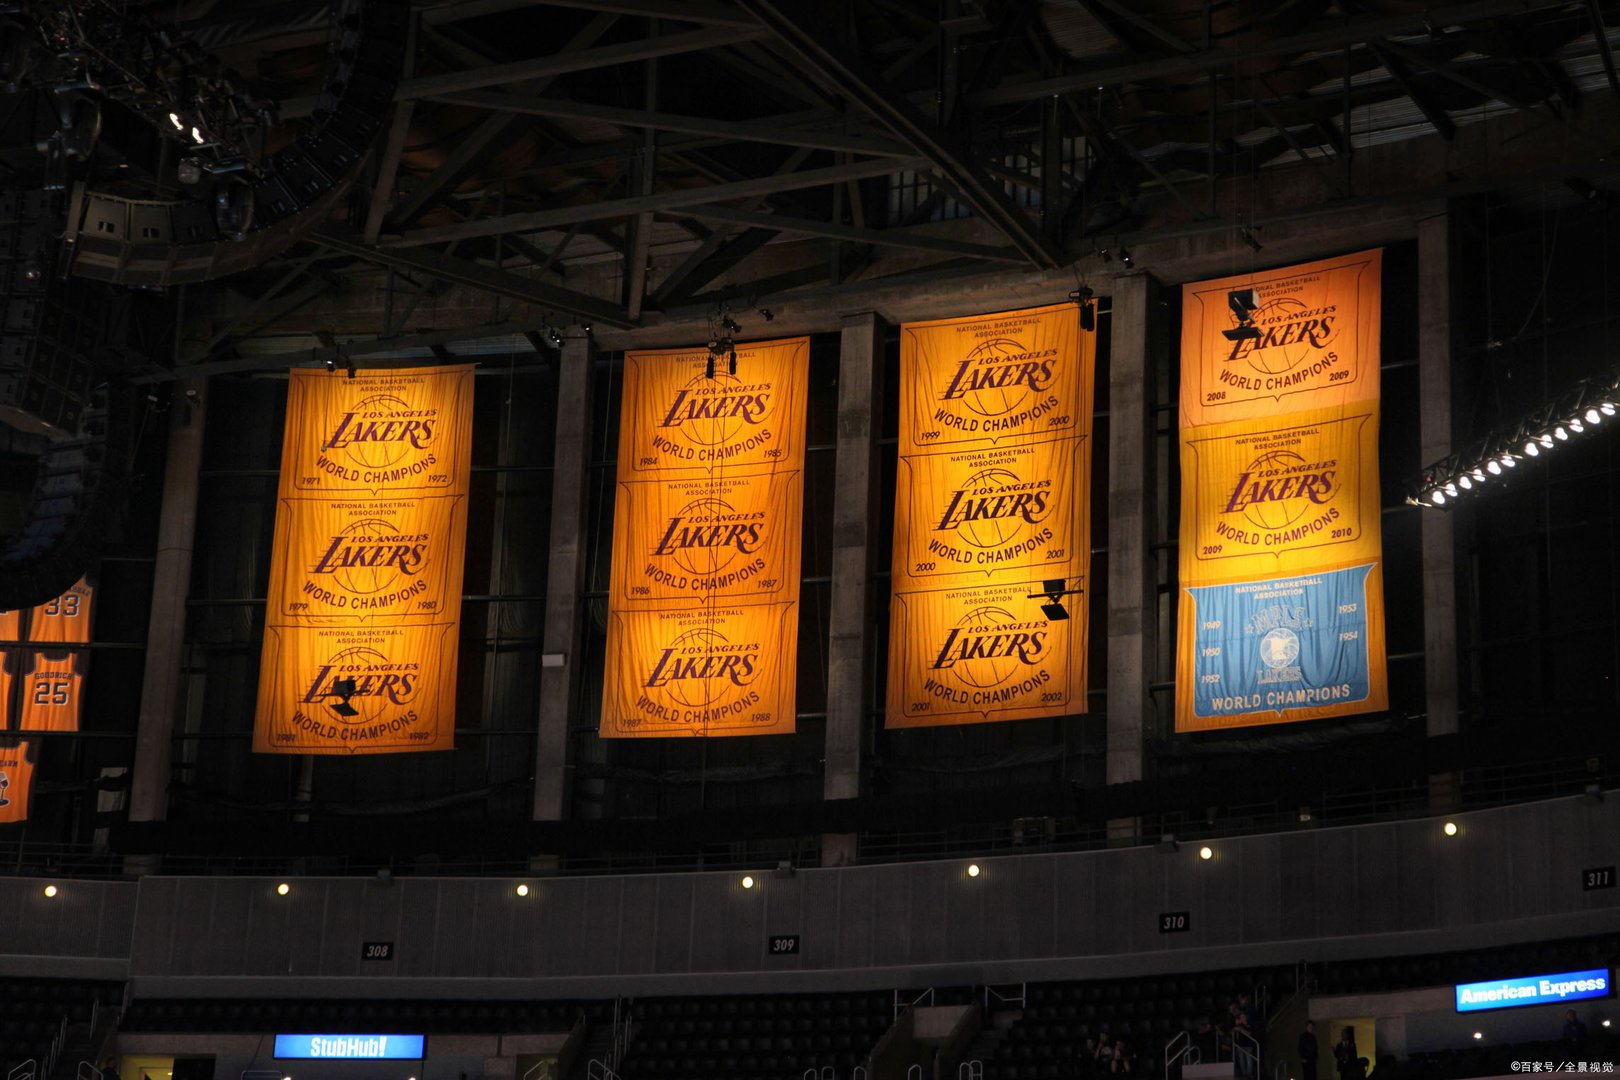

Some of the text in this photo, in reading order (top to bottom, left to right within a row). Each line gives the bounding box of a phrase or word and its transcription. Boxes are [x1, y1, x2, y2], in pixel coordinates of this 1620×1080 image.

[1276, 276, 1320, 288] BASKETBALL
[1262, 305, 1336, 325] LOS ANGELES
[956, 318, 1041, 333] NATIONAL BASKETBALL
[974, 328, 1022, 338] ASSOCIATION
[1002, 349, 1058, 362] ANGELES
[1220, 351, 1338, 390] WORLD CHAMPIONS
[1329, 370, 1349, 381] 2009
[938, 359, 1056, 400] LAKERS
[718, 383, 771, 394] ANGELES
[388, 409, 437, 418] ANGELES
[657, 389, 770, 427] LAKERS
[934, 395, 1058, 431] WORLD CHAMPIONS
[1050, 416, 1070, 426] 2000
[326, 413, 436, 449] LAKERS
[920, 431, 940, 440] 1999
[1236, 428, 1319, 444] NATIONAL BASKETBALL
[653, 428, 771, 460] WORLD CHAMPIONS
[1254, 439, 1301, 449] ASSOCIATION
[988, 448, 1035, 458] BASKETBALL
[316, 454, 437, 482] WORLD CHAMPIONS
[969, 458, 1017, 468] ASSOCIATION
[1258, 460, 1336, 478] LOS ANGELES
[428, 474, 447, 482] 1972
[996, 480, 1051, 493] ANGELES
[1220, 472, 1336, 513] LAKERS
[932, 490, 1050, 530] LAKERS
[712, 512, 765, 522] ANGELES
[1216, 508, 1339, 545] WORLD CHAMPIONS
[1331, 528, 1352, 538] 2010
[376, 534, 429, 542] ANGELES
[649, 518, 764, 555] LAKERS
[928, 528, 1053, 564] WORLD CHAMPIONS
[1203, 546, 1222, 554] 2009
[308, 537, 427, 575] LAKERS
[1046, 549, 1064, 559] 2001
[916, 563, 936, 571] 2000
[644, 558, 765, 590] WORLD CHAMPIONS
[757, 580, 776, 588] 1987
[1235, 578, 1322, 593] NATIONAL BASKETBALL
[303, 580, 427, 609] WORLD CHAMPIONS
[1254, 588, 1303, 599] ASSOCIATION
[289, 603, 308, 611] 1979
[417, 601, 436, 609] 1980
[964, 596, 1012, 605] ASSOCIATION
[1339, 604, 1357, 614] 1953
[992, 620, 1049, 631] ANGELES
[706, 643, 760, 653] ANGELES
[928, 628, 1047, 669] LAKERS
[364, 663, 419, 671] ANGELES
[641, 649, 758, 687] LAKERS
[35, 682, 70, 705] 25
[924, 670, 1050, 704] WORLD CHAMPIONS
[1041, 692, 1062, 701] 2002
[1212, 684, 1350, 710] WORLD CHAMPIONS
[636, 691, 759, 723] WORLD CHAMPIONS
[623, 719, 641, 727] 1987
[752, 713, 770, 721] 1988
[292, 710, 418, 740] WORLD CHAMPIONS
[1588, 871, 1608, 886] 311
[1164, 916, 1184, 929] 310
[367, 946, 388, 957] 308
[774, 939, 794, 951] 309
[1460, 978, 1606, 1004] American Express
[310, 1036, 387, 1057] StubHub!
